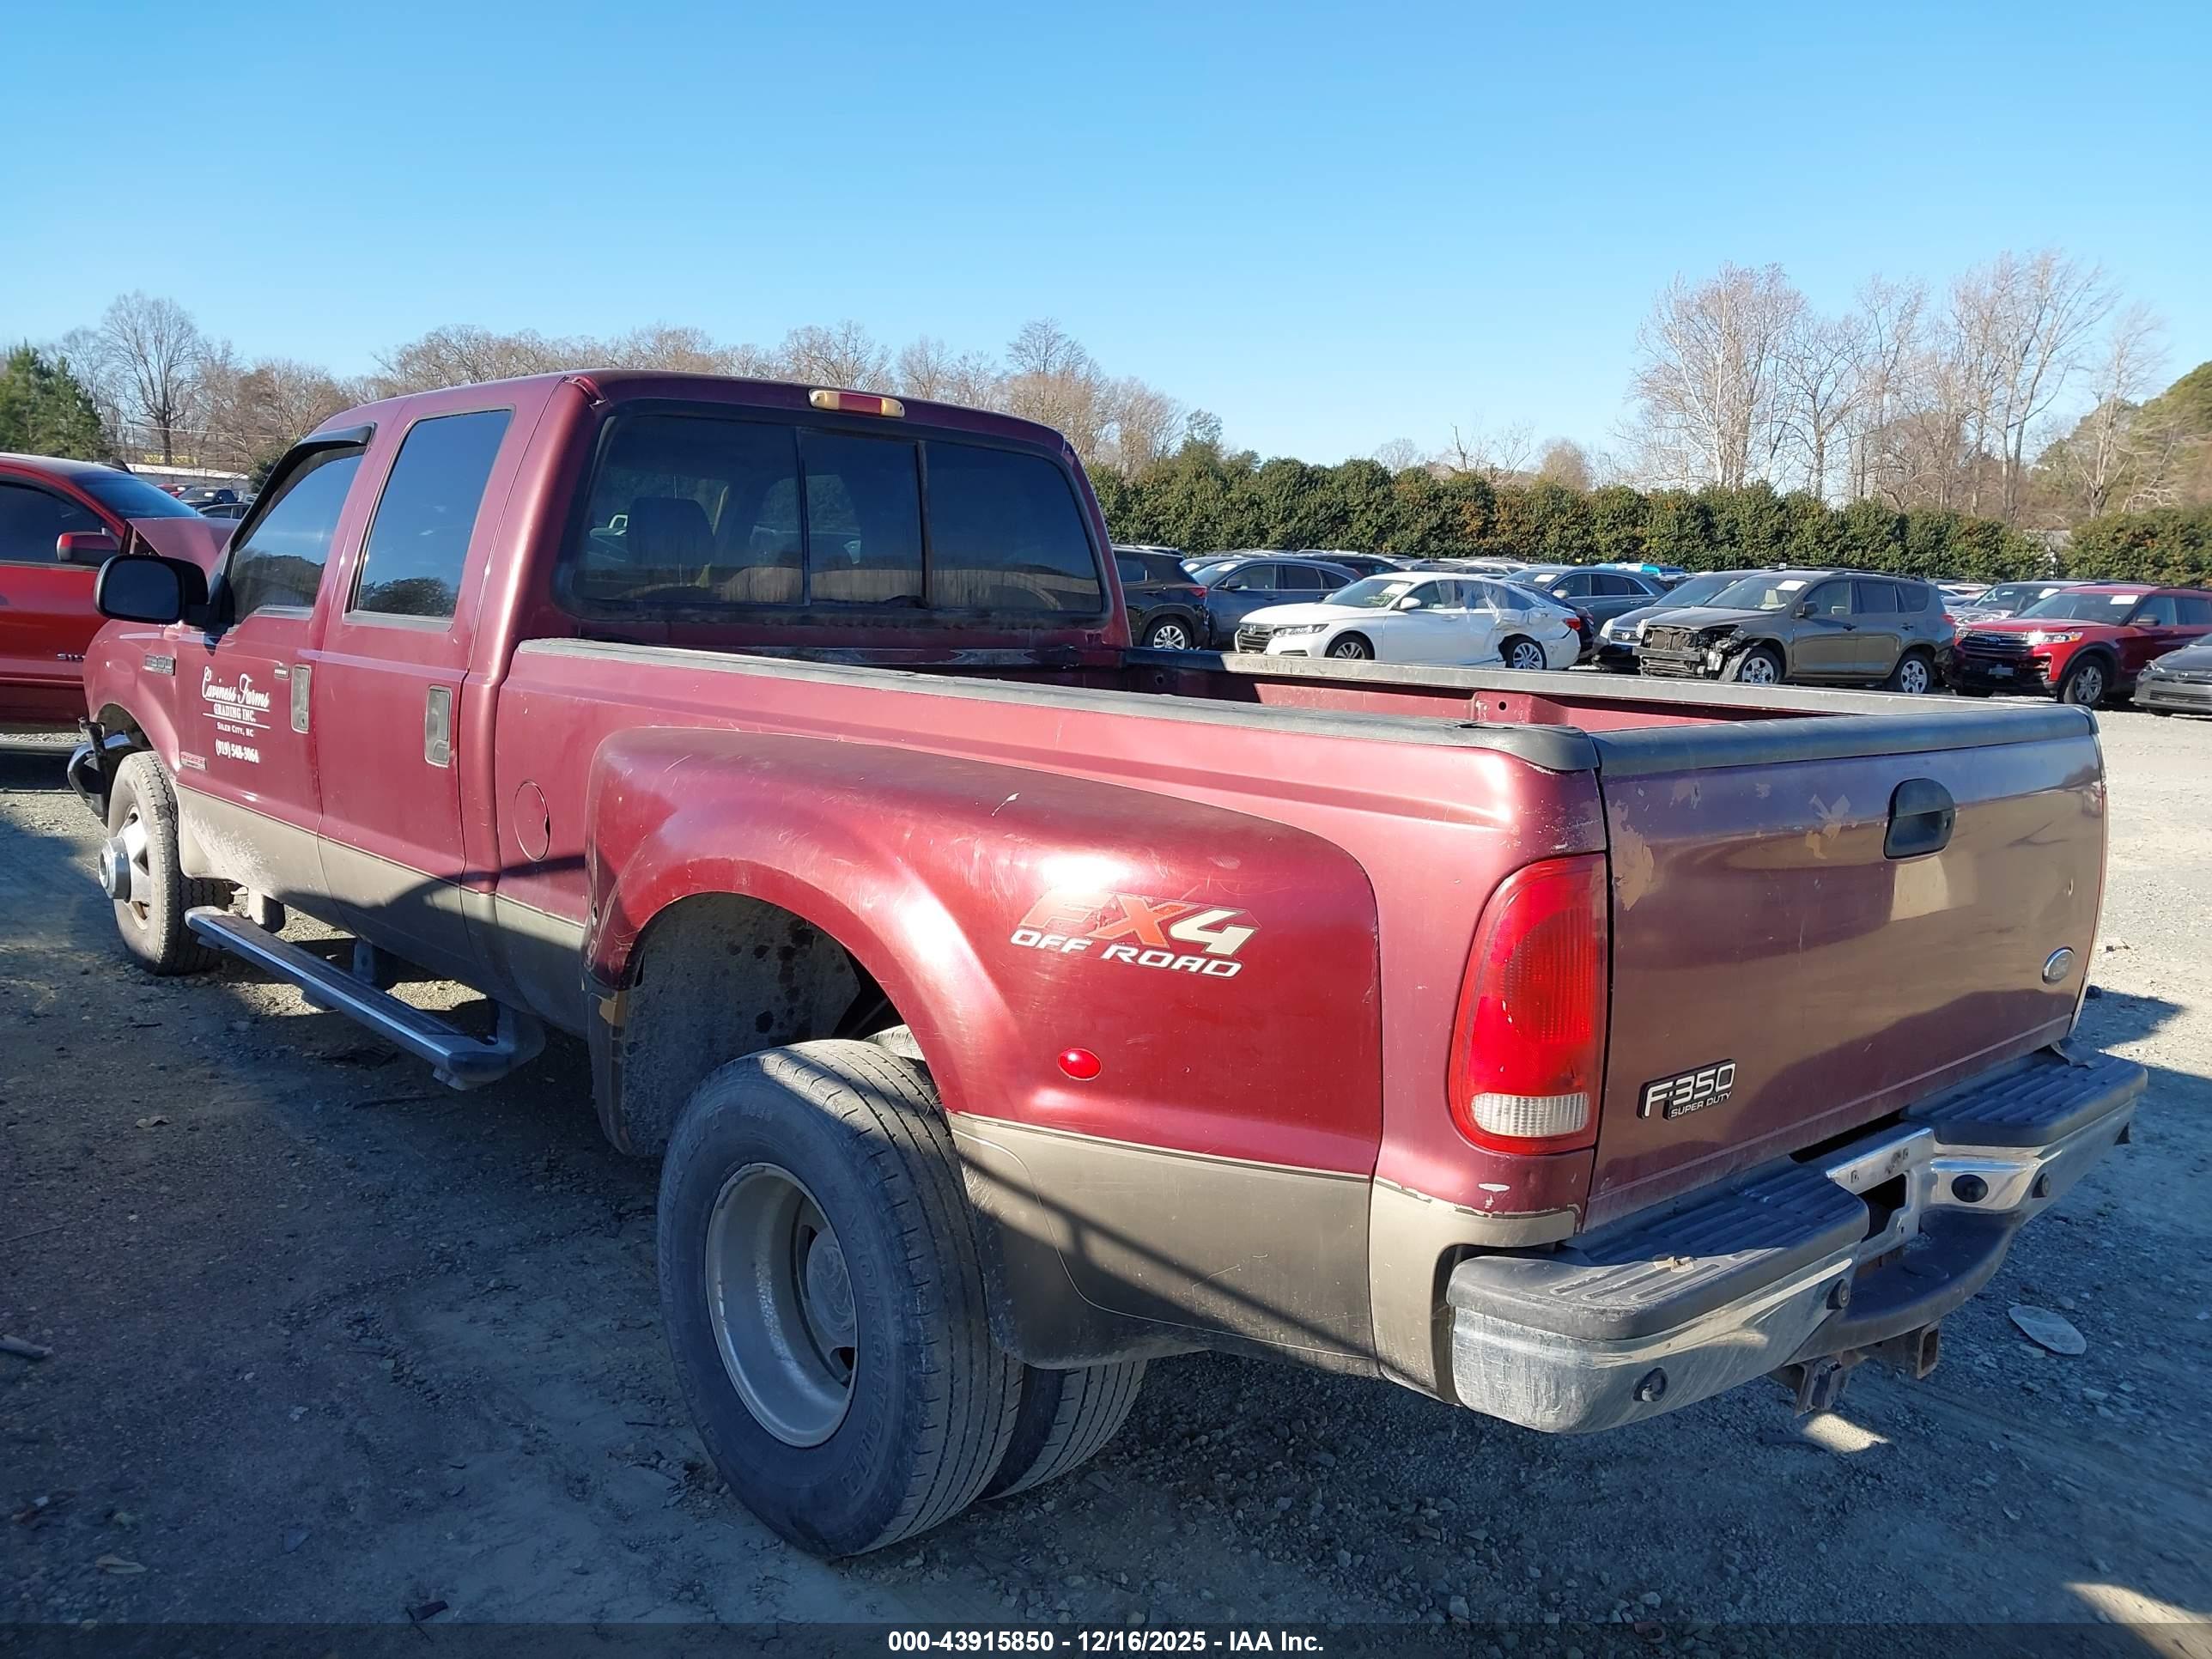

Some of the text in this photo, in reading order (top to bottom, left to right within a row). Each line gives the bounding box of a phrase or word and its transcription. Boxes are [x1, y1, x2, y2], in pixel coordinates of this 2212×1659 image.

[238, 673, 270, 708] Farms
[214, 702, 256, 722] GRADING INC.
[216, 738, 231, 759] (919)
[1018, 890, 1260, 956] FX4
[1010, 928, 1243, 978] OFF ROAD
[1670, 1091, 1732, 1118] SUPER DUTY
